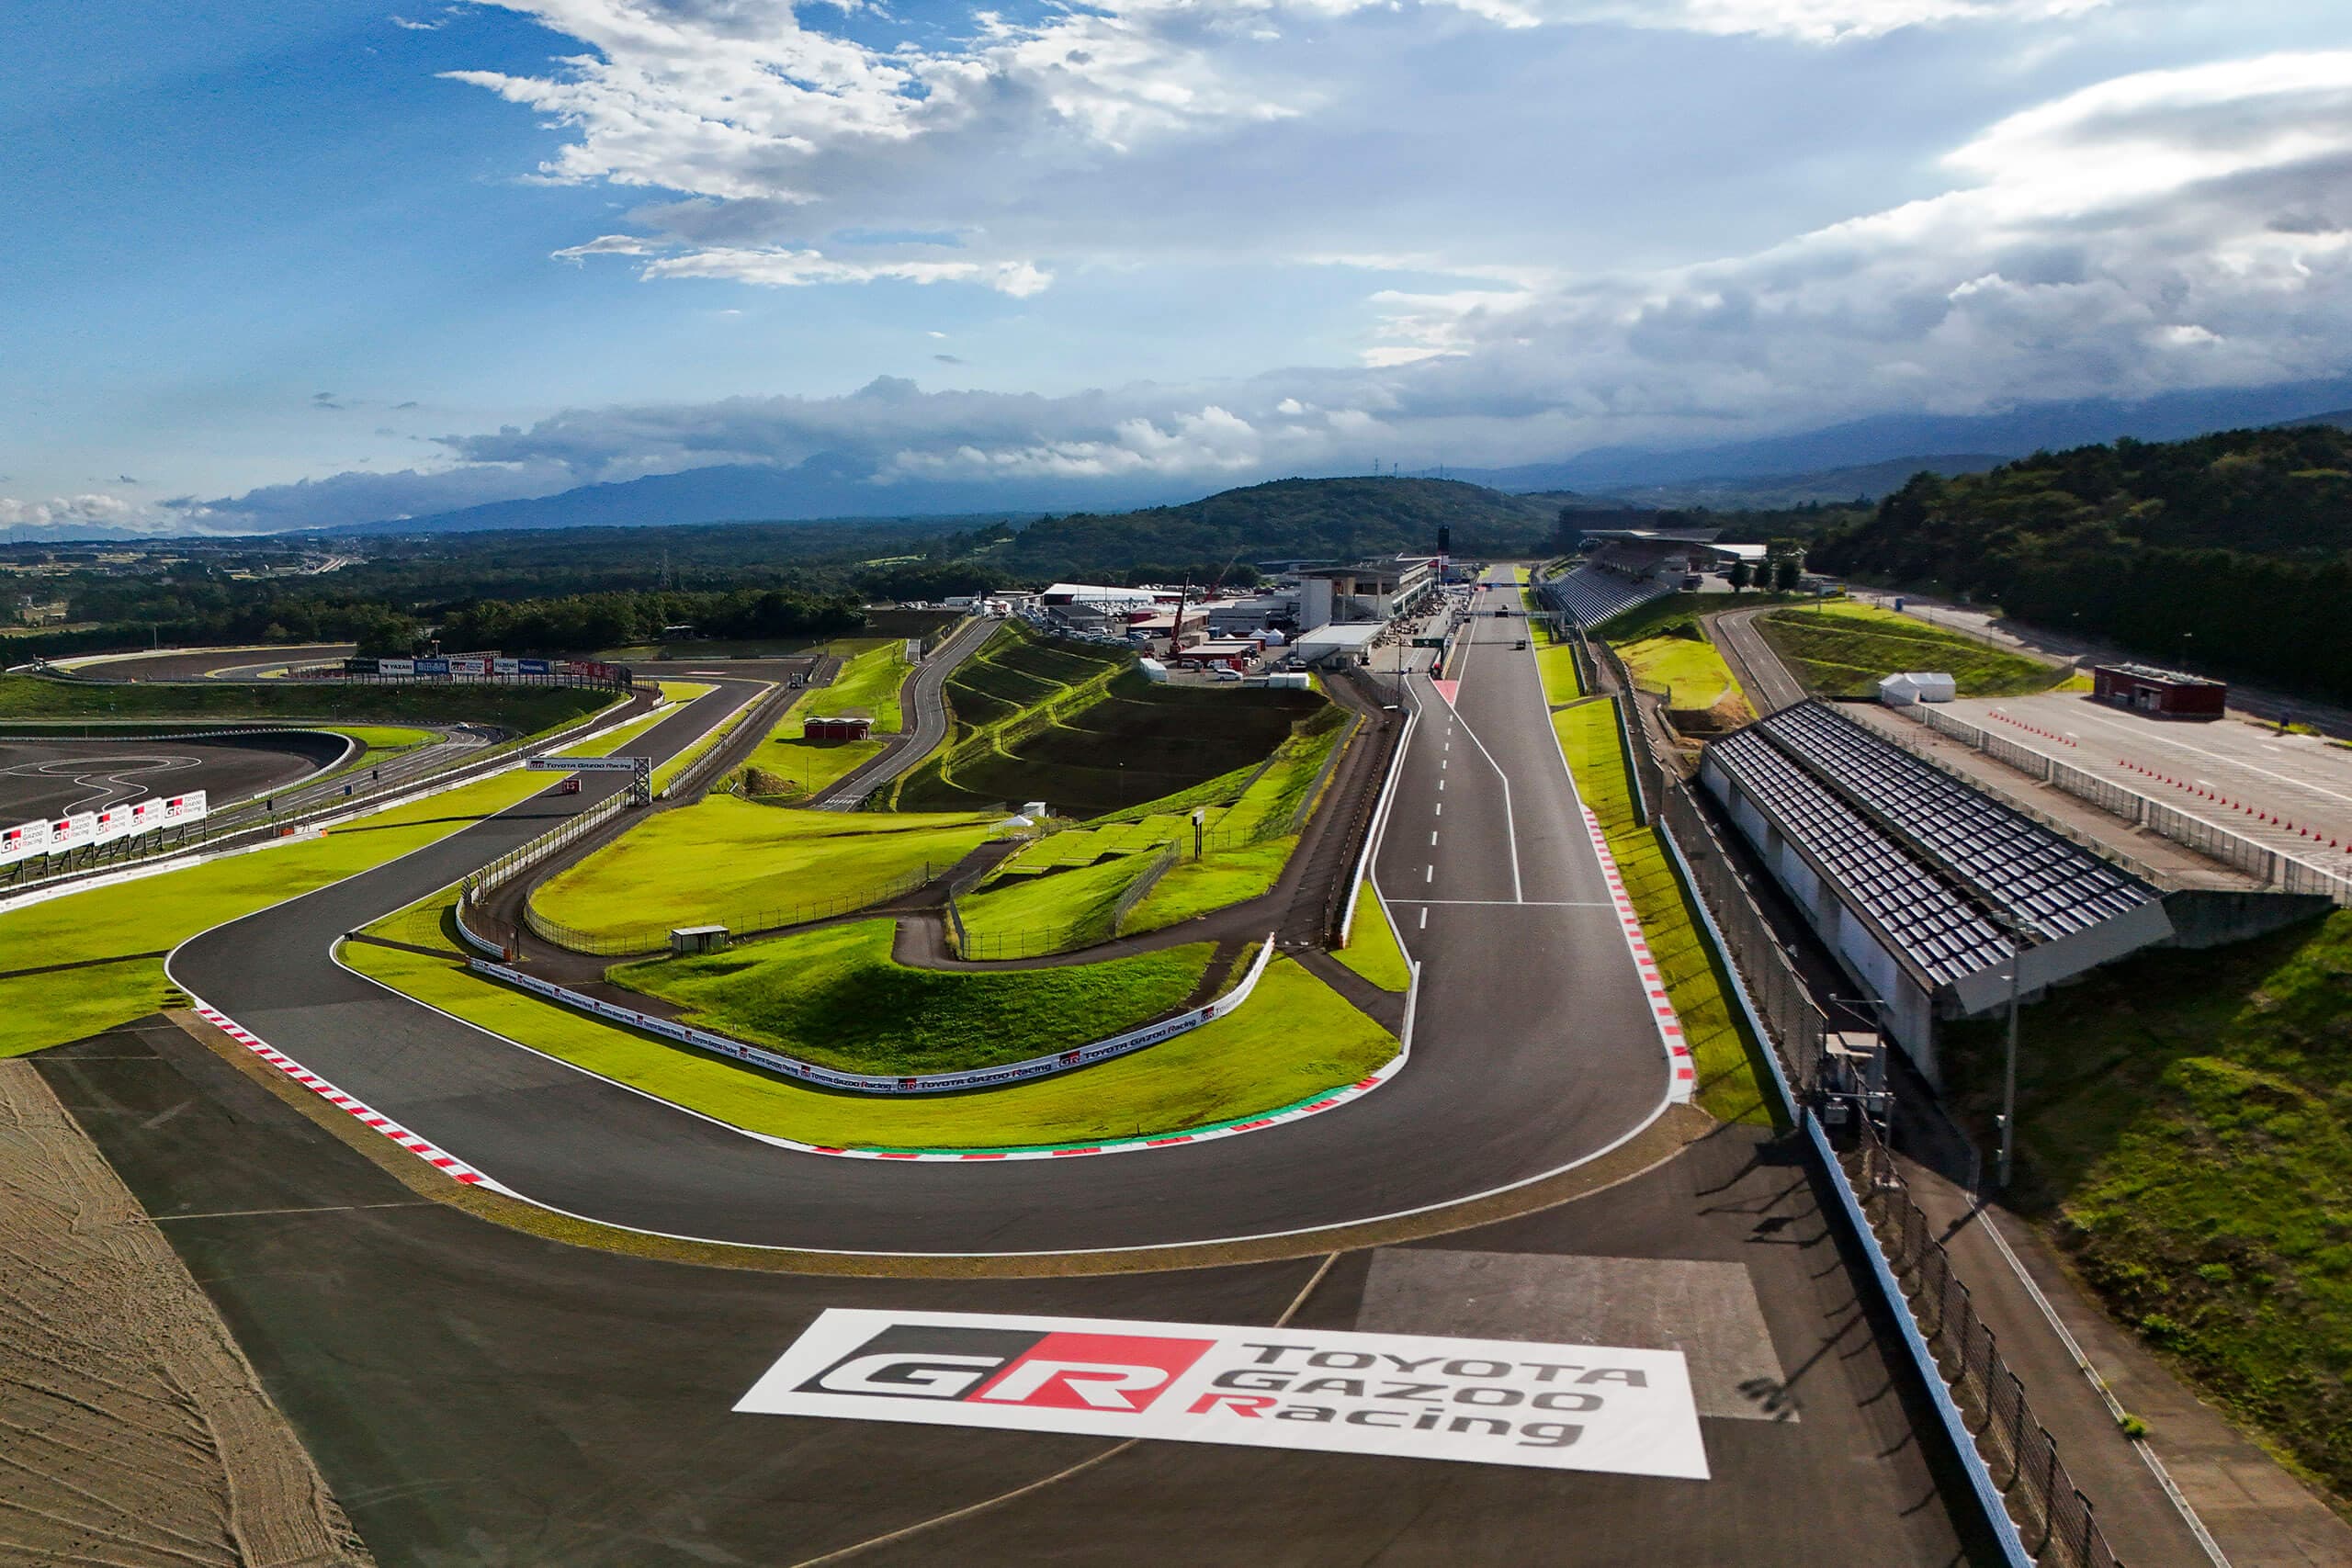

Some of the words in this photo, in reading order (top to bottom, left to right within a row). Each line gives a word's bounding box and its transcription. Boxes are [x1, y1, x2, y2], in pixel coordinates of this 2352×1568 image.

[132, 811, 147, 827] GR
[164, 804, 183, 818] GR
[51, 827, 70, 843] GR
[96, 819, 110, 835] GR
[2, 835, 21, 853] GR
[1059, 1055, 1080, 1066] GR
[1084, 1043, 1127, 1058] TOYOTA
[1130, 1030, 1166, 1046] GAZOO
[1168, 1019, 1196, 1033] Racing
[811, 1073, 832, 1083] TOYOTA
[833, 1077, 859, 1088] GAZOO
[861, 1081, 891, 1091] Racing
[898, 1080, 916, 1089] GR
[921, 1079, 964, 1089] TOYOTA
[967, 1072, 1009, 1083] GAZOO
[1012, 1064, 1051, 1077] Racing
[1241, 1342, 1648, 1388] TOYOTA
[816, 1348, 1177, 1410] GR
[1211, 1368, 1605, 1412] GAZOO
[1185, 1392, 1585, 1448] Racing
